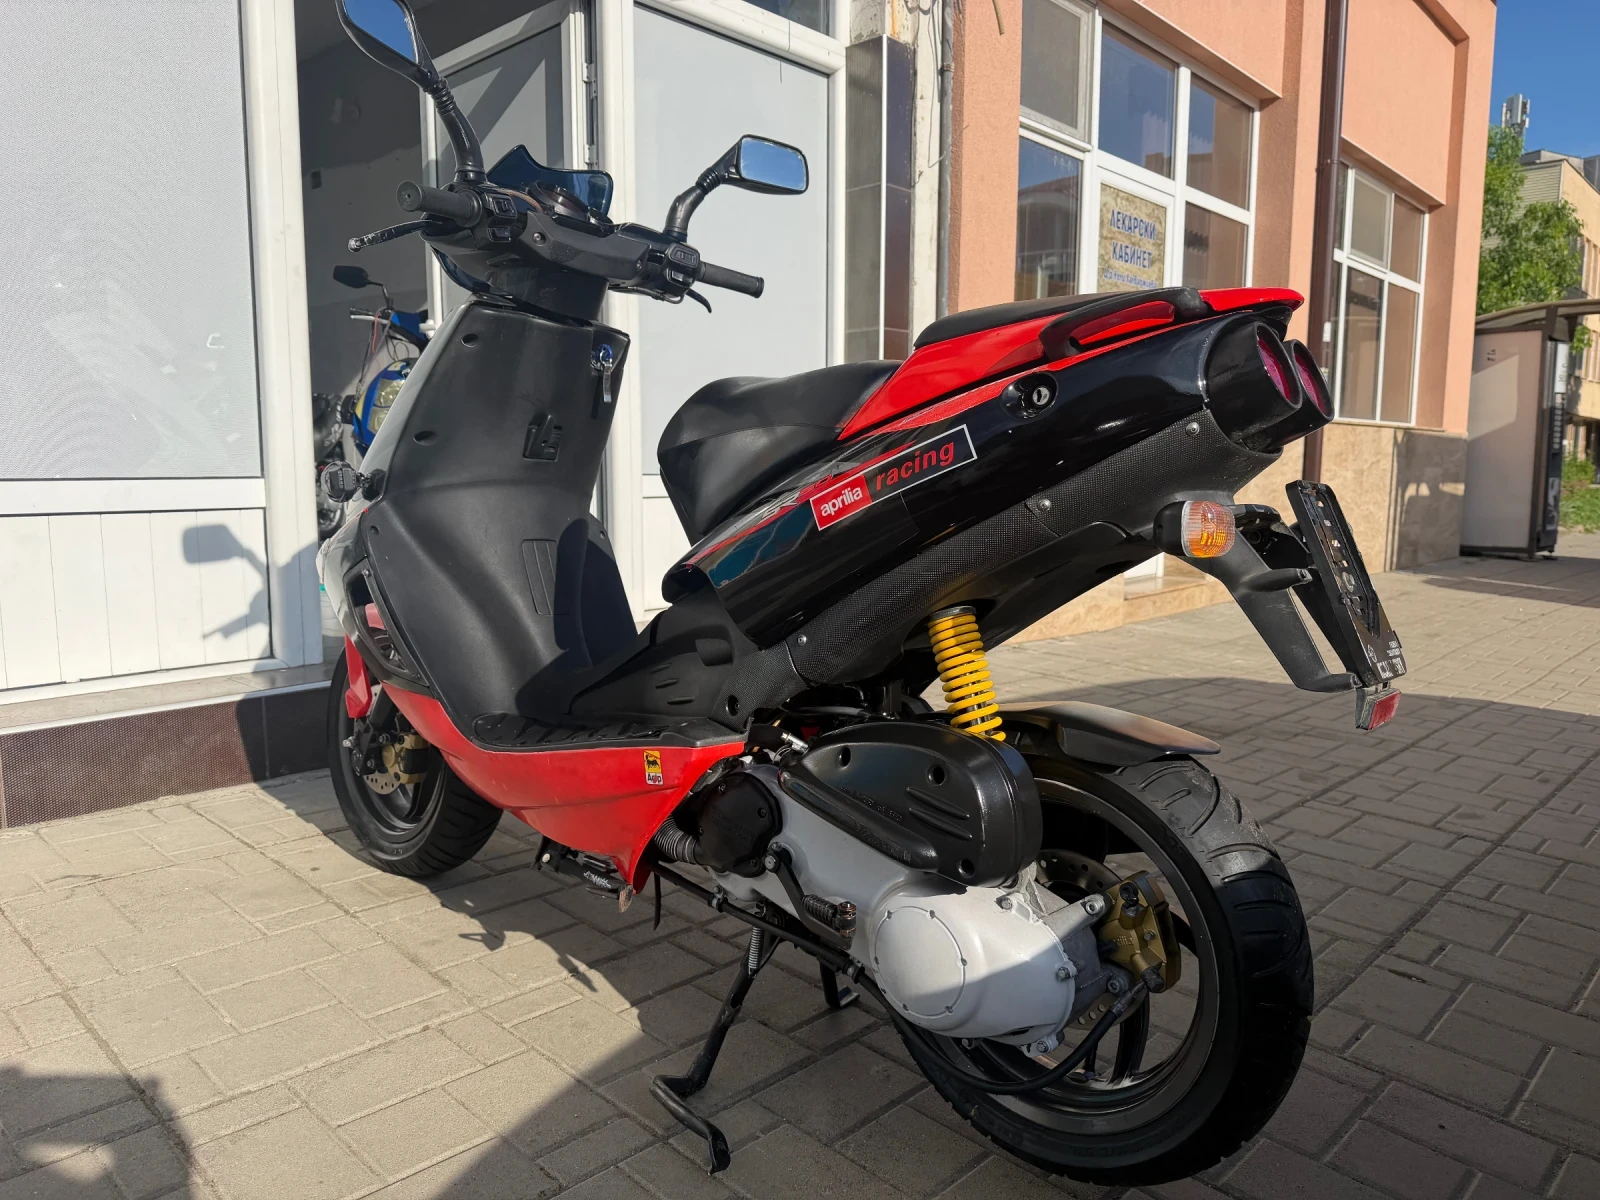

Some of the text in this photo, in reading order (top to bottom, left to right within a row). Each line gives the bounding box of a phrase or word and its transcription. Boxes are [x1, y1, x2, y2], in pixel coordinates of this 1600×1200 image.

[1109, 209, 1157, 241] ЛЕКАРСКИ
[1112, 241, 1153, 269] КАБИНЕТ
[820, 441, 955, 516] aprilia racing
